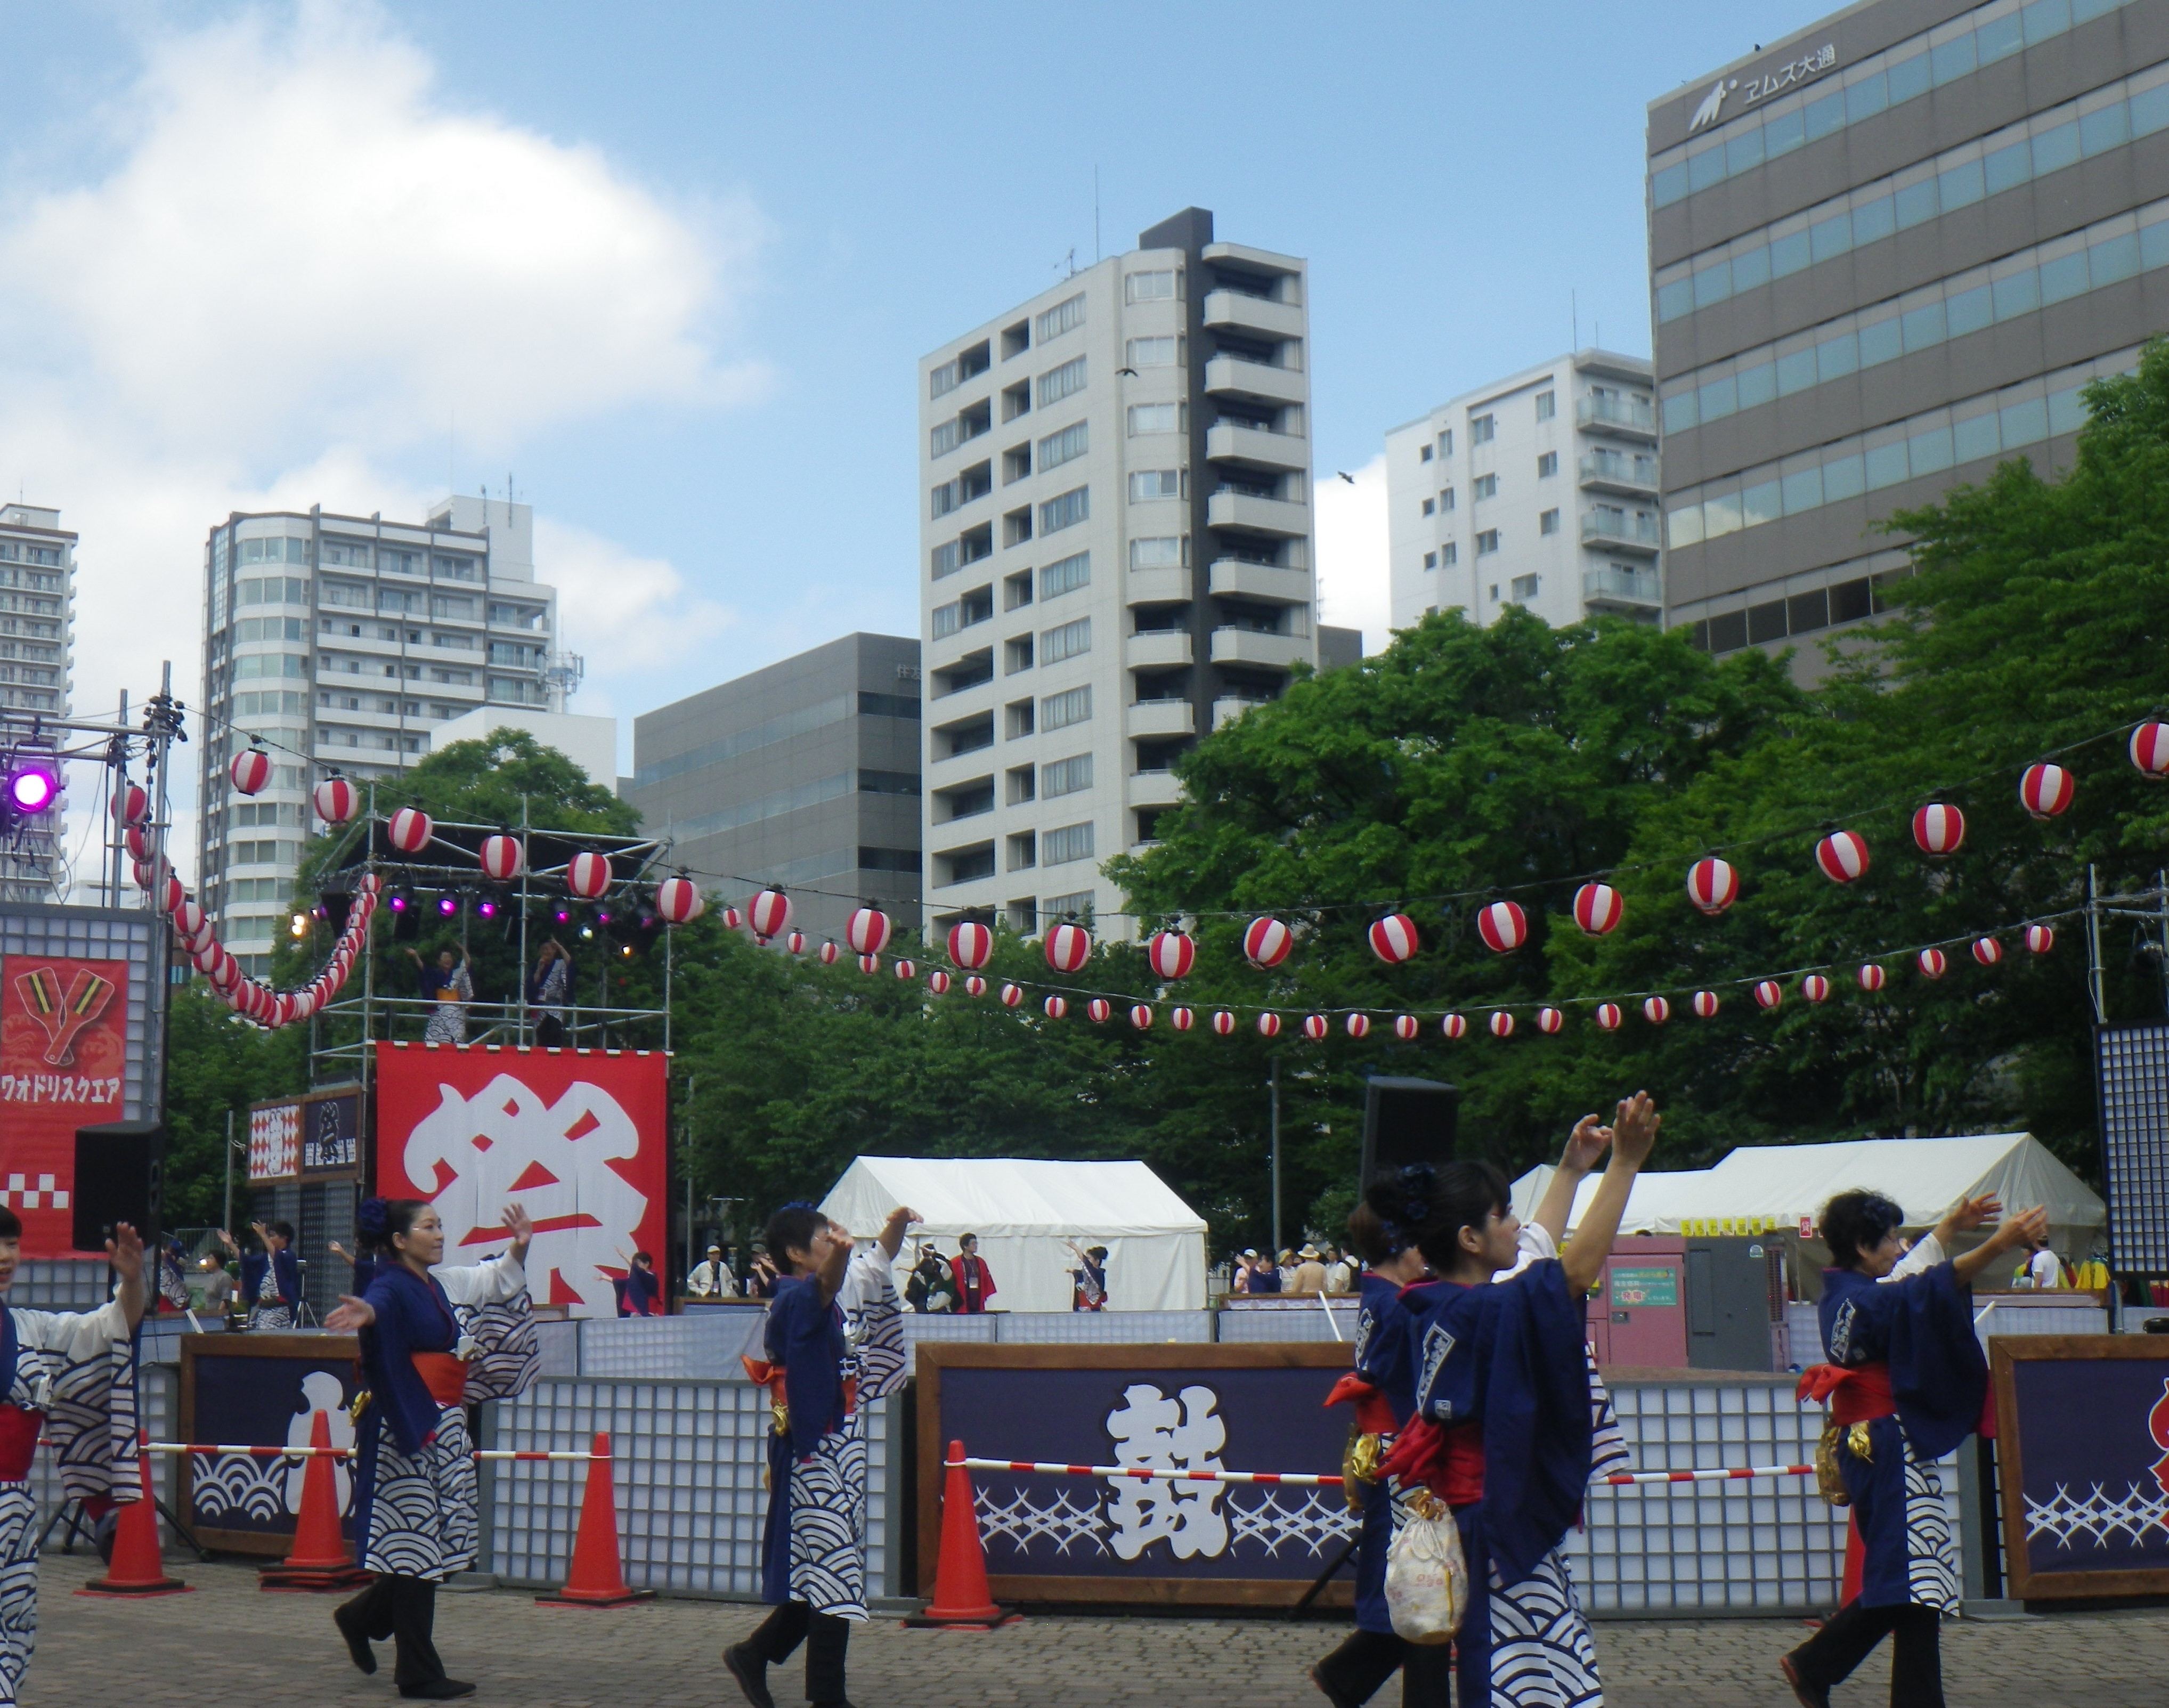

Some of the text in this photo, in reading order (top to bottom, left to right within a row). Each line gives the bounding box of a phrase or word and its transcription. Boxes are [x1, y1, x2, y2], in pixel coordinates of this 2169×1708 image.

[2, 1073, 120, 1104] ワオドリスクエア
